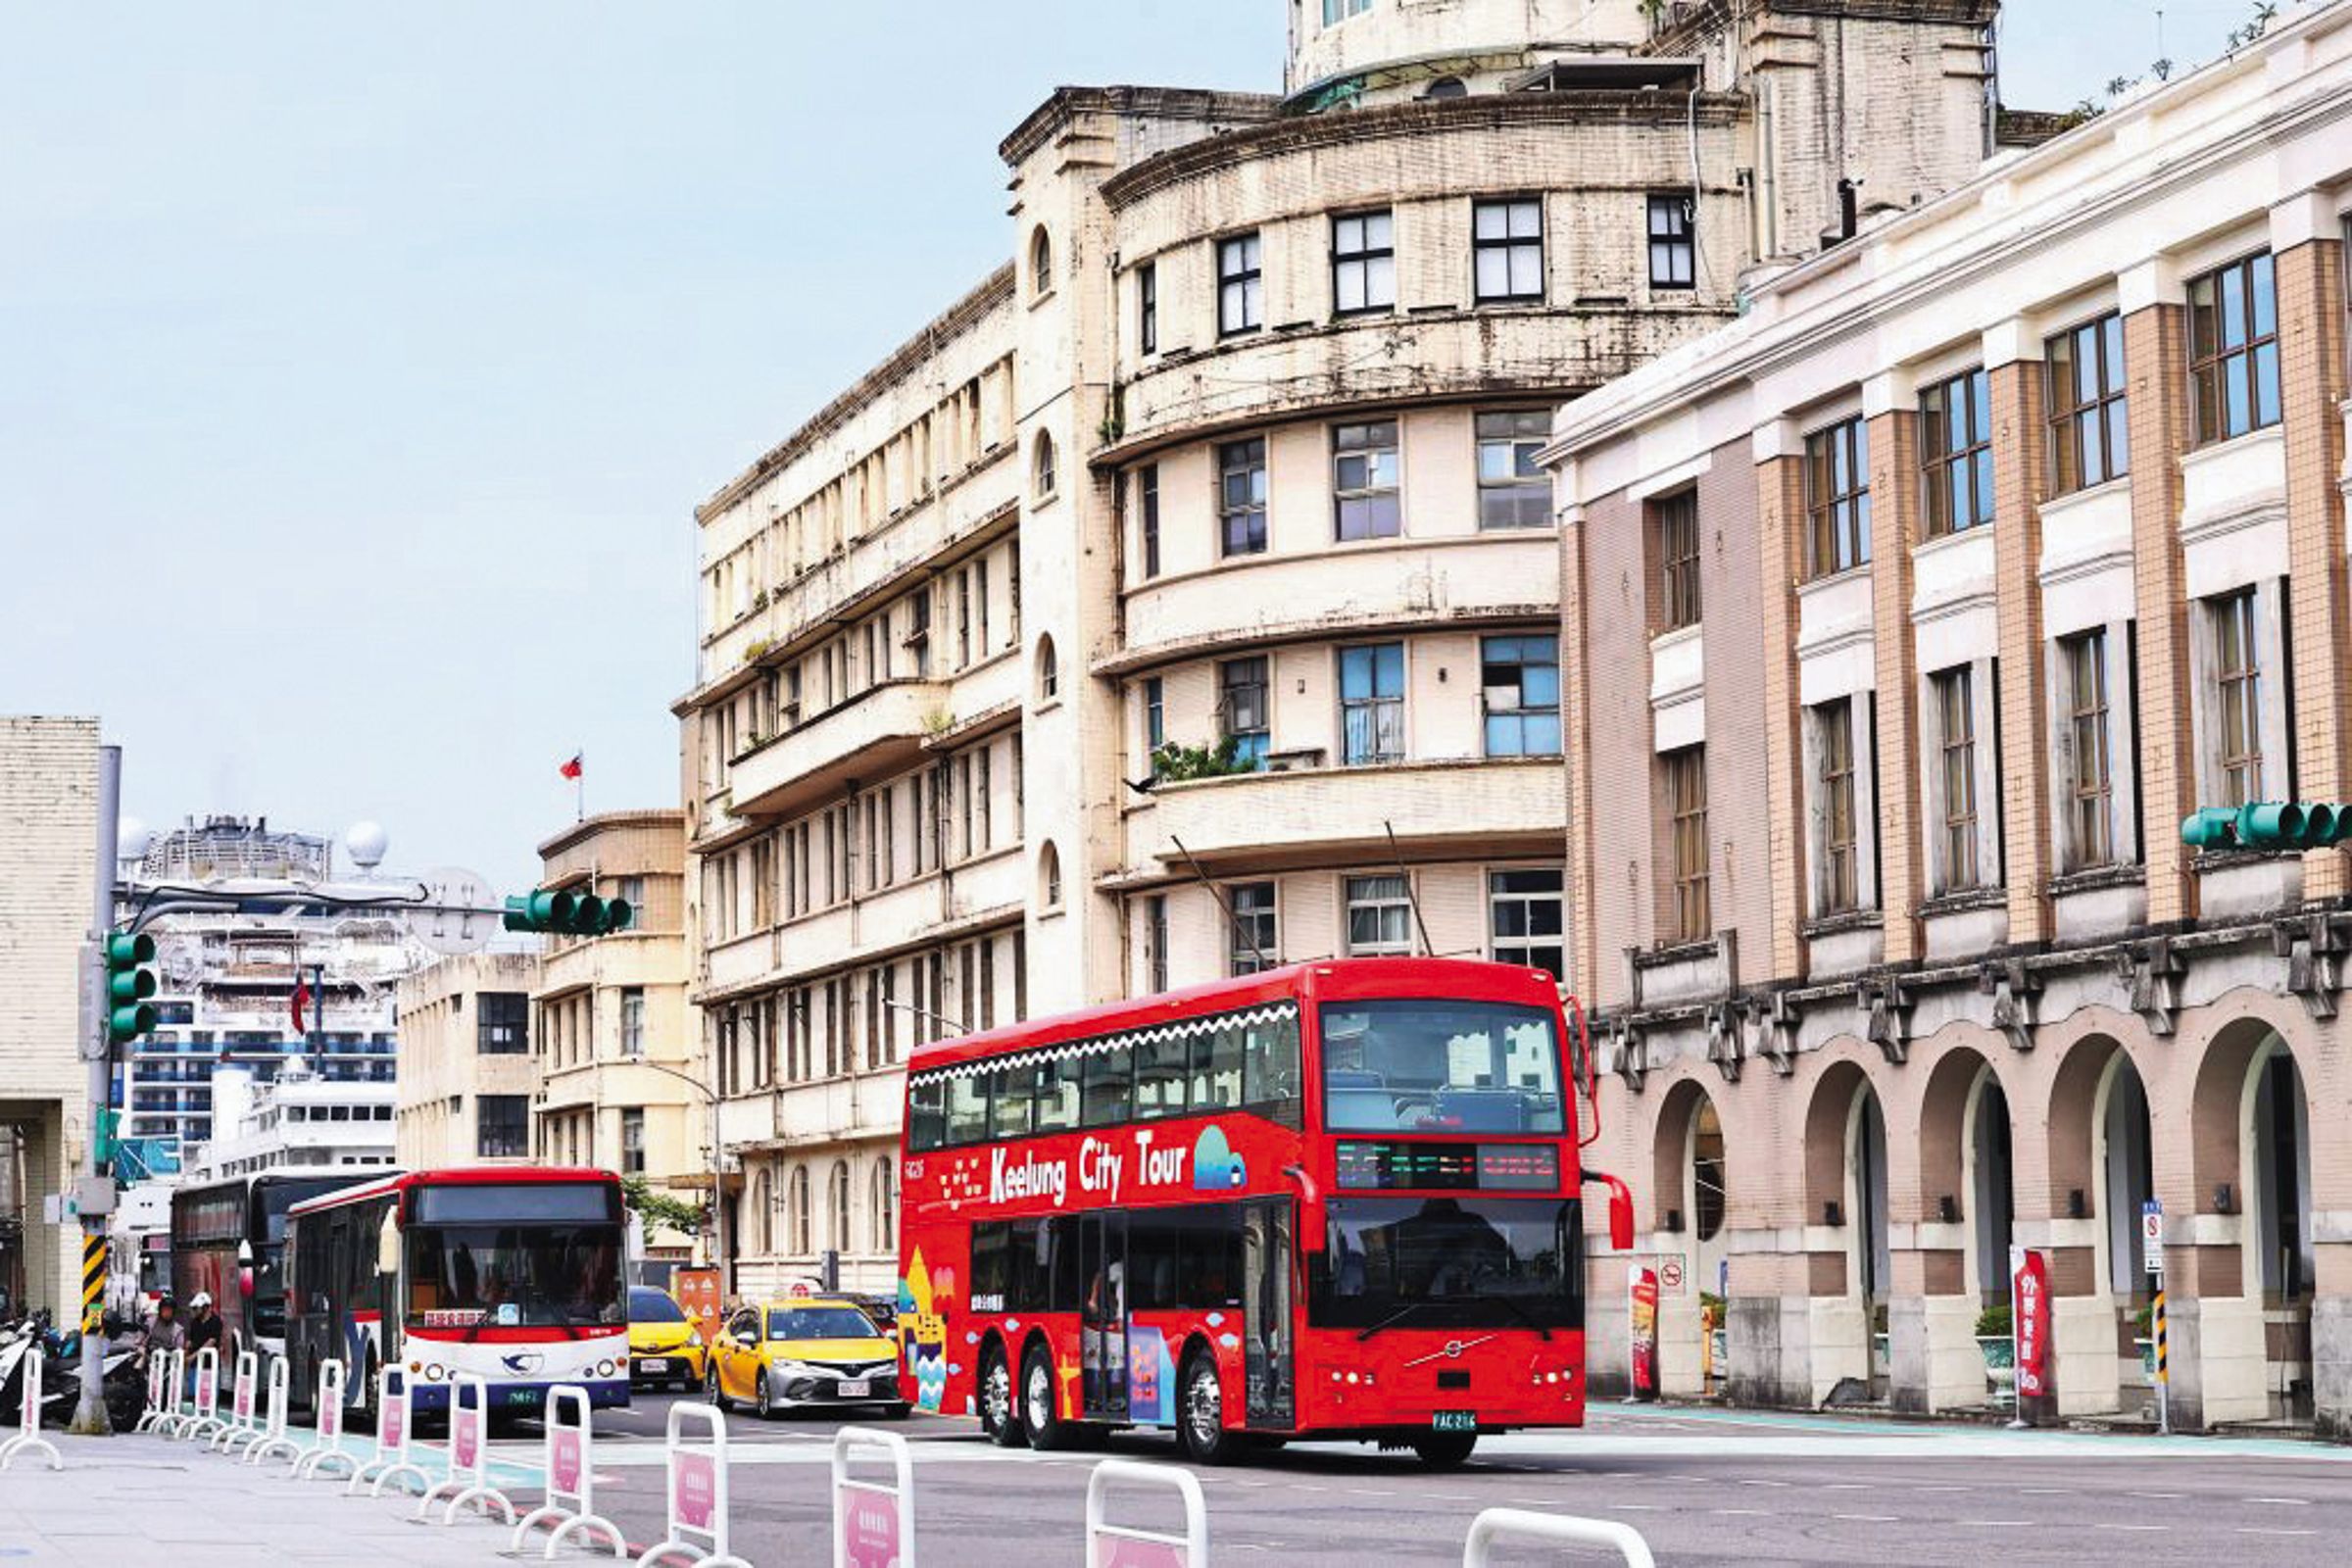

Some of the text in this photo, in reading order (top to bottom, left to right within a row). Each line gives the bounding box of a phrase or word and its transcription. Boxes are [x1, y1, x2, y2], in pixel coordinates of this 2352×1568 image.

[990, 1129, 1188, 1206] Keelung City Tour
